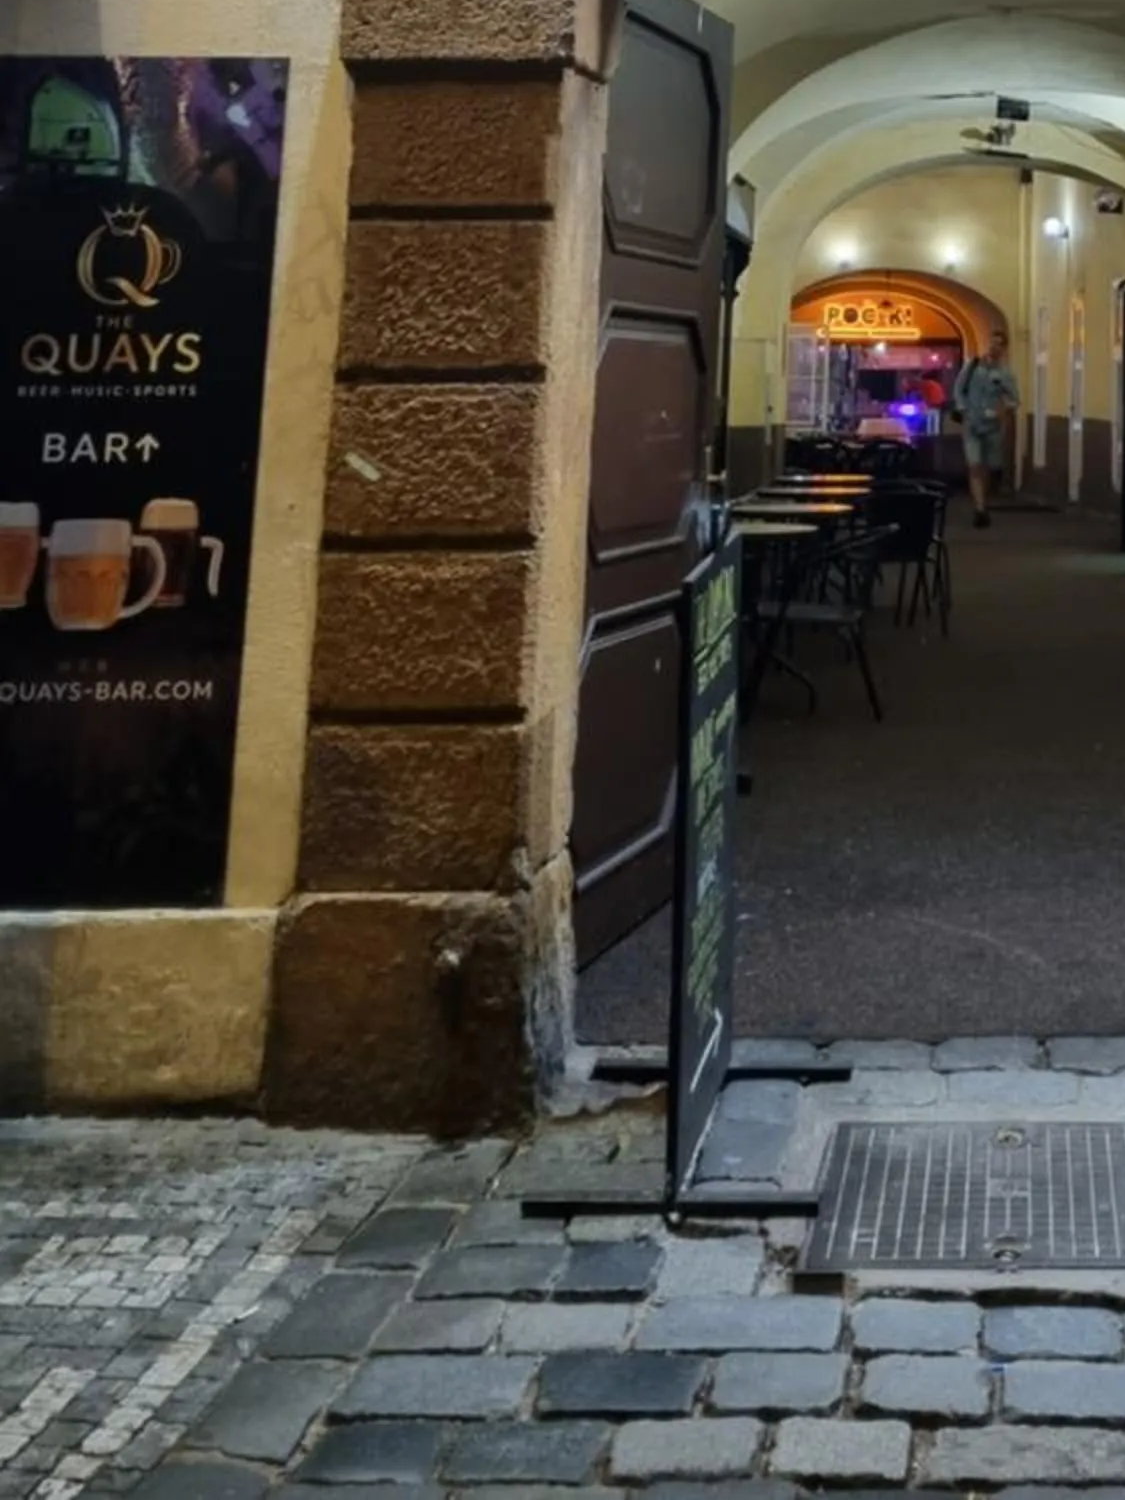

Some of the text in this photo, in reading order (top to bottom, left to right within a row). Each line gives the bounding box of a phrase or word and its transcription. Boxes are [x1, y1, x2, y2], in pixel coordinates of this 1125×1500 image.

[95, 314, 135, 329] THE
[20, 331, 203, 377] QUAYS
[70, 384, 124, 398] MUSIC
[132, 384, 198, 398] SPORTS
[42, 434, 128, 463] BAR
[0, 680, 213, 704] QUAYS-BAR.COM
